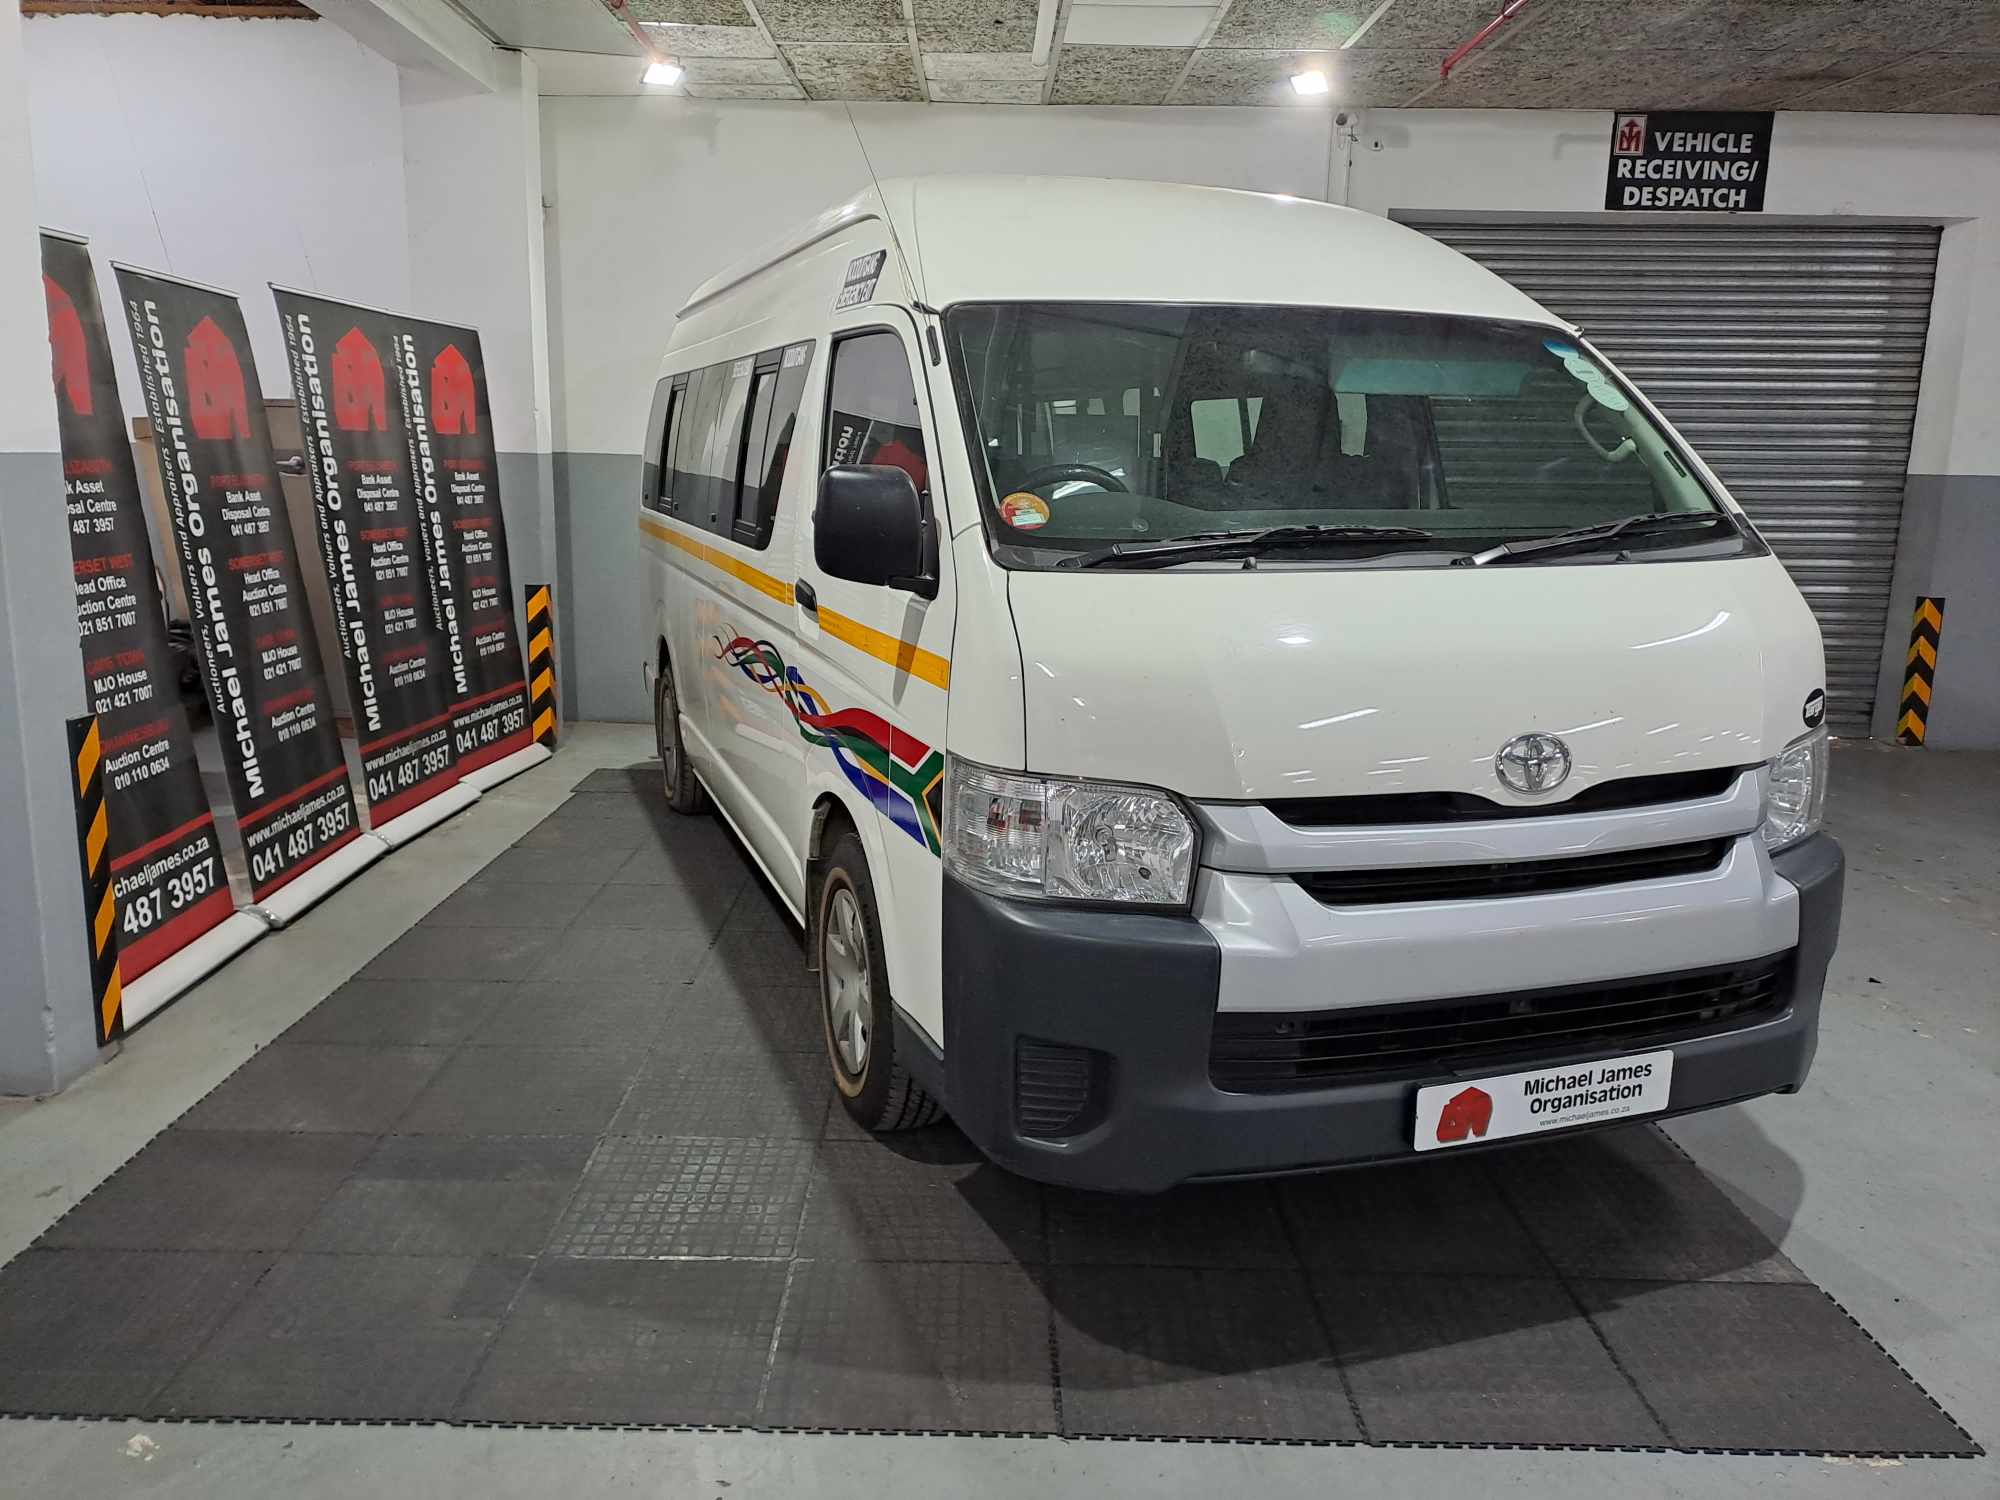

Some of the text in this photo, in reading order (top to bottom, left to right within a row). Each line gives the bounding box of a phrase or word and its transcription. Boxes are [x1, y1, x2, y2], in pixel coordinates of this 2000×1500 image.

[1654, 132, 1754, 154] VEHICLE
[1616, 158, 1759, 182] RECEIVING/
[1622, 186, 1747, 208] DESPATCH
[129, 300, 145, 340] 1964
[137, 342, 165, 434] Established
[75, 480, 105, 494] Asset
[162, 447, 184, 527] Appraisers
[307, 435, 327, 504] Appraisers
[87, 499, 118, 513] Centre
[298, 313, 382, 732] Michael James Organisation
[317, 505, 328, 530] and
[402, 334, 468, 694] Michael James Organisation
[72, 517, 115, 535] 487 3957
[144, 300, 264, 799] Michael James Organisation
[179, 530, 192, 560] and
[322, 533, 337, 579] Valuers
[97, 575, 127, 591] Office
[187, 563, 204, 619] Valuers
[107, 594, 136, 610] Centre
[95, 616, 114, 633] 851
[115, 611, 137, 628] 7007
[333, 583, 352, 659] Auctioneers,
[93, 669, 148, 695] MJO House
[200, 624, 226, 713] Auctioneers,
[95, 684, 153, 714] 021 421 7007
[456, 708, 525, 754] 041 487 3957
[105, 739, 170, 774] Auction Centre
[114, 756, 170, 790] 010 110 0634
[369, 744, 450, 801] 041 487 3957
[247, 784, 346, 848] www.michaeljames.co.za
[252, 802, 351, 881] 041 487 3957
[114, 836, 210, 898] chaeljames.co.za
[123, 857, 216, 935] 487 3957
[1524, 1063, 1653, 1097] Michael James
[1530, 1083, 1643, 1115] Organisation
[1539, 1106, 1631, 1127] www.michaeljames.co.za
